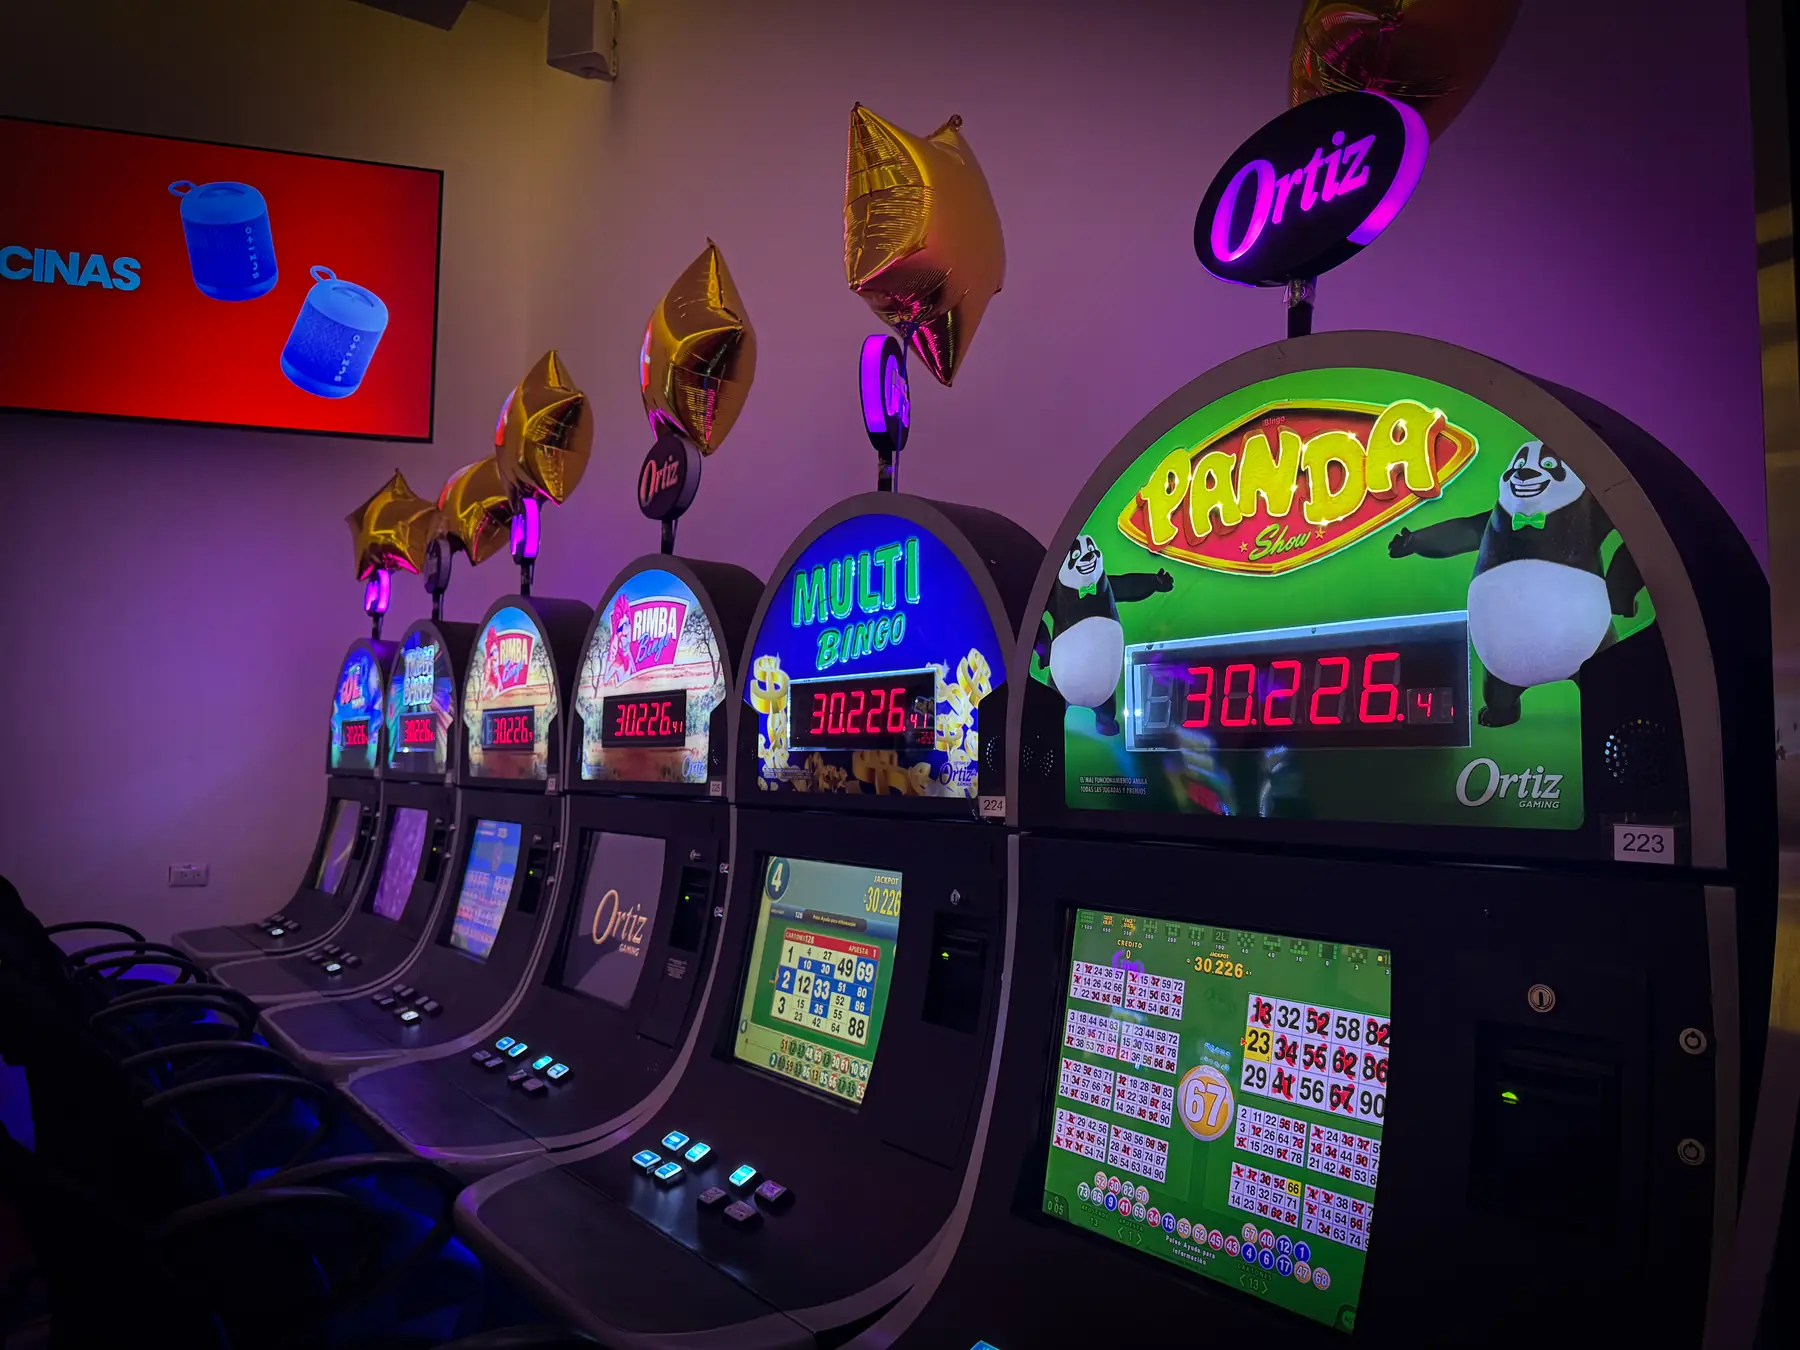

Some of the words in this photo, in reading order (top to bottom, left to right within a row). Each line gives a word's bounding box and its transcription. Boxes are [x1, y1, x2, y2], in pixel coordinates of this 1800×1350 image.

[1211, 130, 1376, 262] Ortiz
[0, 245, 141, 291] CINAS
[640, 453, 680, 505] Ortiz
[1139, 400, 1443, 548] PANDA
[1249, 523, 1312, 561] Show
[791, 536, 922, 627] MULTI
[632, 605, 677, 641] RIMBA
[815, 613, 907, 670] BINGO
[940, 760, 972, 786] Ortiz
[1455, 757, 1564, 807] Ortiz
[983, 799, 1003, 811] 224
[1519, 800, 1560, 809] GAMING
[1622, 832, 1665, 854] 223
[771, 862, 783, 892] 4
[873, 875, 899, 885] JACKPOT
[592, 889, 648, 946] Ortiz
[1117, 939, 1143, 949] CREDITO
[1209, 951, 1229, 959] JACKPOT
[788, 946, 793, 963] 1
[823, 951, 832, 961] 27
[838, 958, 853, 977] 49
[856, 961, 874, 983] 69
[803, 960, 812, 969] 10
[821, 964, 830, 975] 30
[1115, 970, 1124, 980] 57
[781, 971, 791, 989] 2
[798, 975, 811, 994] 12
[814, 979, 830, 1000] 33
[837, 982, 846, 993] 51
[857, 987, 867, 998] 80
[1081, 989, 1090, 998] 22
[1162, 979, 1171, 989] 59
[1174, 981, 1183, 992] 72
[835, 996, 845, 1006] 52
[855, 1001, 865, 1012] 86
[778, 997, 786, 1014] 3
[797, 999, 805, 1009] 15
[814, 1004, 824, 1014] 35
[833, 1010, 843, 1020] 55
[848, 1017, 865, 1039] 88
[1171, 1007, 1180, 1018] 74
[794, 1012, 802, 1022] 23
[812, 1017, 821, 1028] 42
[831, 1023, 840, 1034] 64
[1253, 1001, 1273, 1024] 13
[1277, 1006, 1300, 1030] 32
[1306, 1011, 1330, 1036] 52
[1335, 1016, 1360, 1041] 58
[1366, 1021, 1390, 1047] 82
[1098, 1031, 1105, 1041] 71
[1168, 1034, 1178, 1045] 72
[1247, 1030, 1270, 1054] 23
[1274, 1038, 1297, 1063] 34
[1302, 1044, 1327, 1070] 55
[1333, 1050, 1358, 1077] 62
[1363, 1056, 1388, 1083] 86
[1162, 1087, 1172, 1098] 83
[1244, 1065, 1266, 1089] 29
[1272, 1072, 1292, 1096] 41
[1299, 1077, 1324, 1103] 56
[1330, 1084, 1355, 1110] 67
[1360, 1091, 1386, 1118] 90
[1101, 1097, 1110, 1107] 87
[1161, 1101, 1171, 1112] 84
[1185, 1078, 1227, 1128] 67
[1253, 1112, 1262, 1123] 11
[1278, 1133, 1289, 1145] 64
[1326, 1131, 1338, 1143] 24
[1096, 1149, 1104, 1160] 74
[1144, 1151, 1153, 1162] 74
[1291, 1151, 1302, 1164] 78
[1340, 1150, 1352, 1163] 44
[1109, 1154, 1118, 1165] 36
[1154, 1169, 1164, 1180] 90
[1095, 1175, 1106, 1186] 52
[1109, 1180, 1119, 1191] 30
[1354, 1169, 1367, 1182] 53
[1246, 1184, 1256, 1196] 18
[1258, 1188, 1270, 1201] 32
[1288, 1182, 1299, 1194] 66
[1321, 1208, 1331, 1220] 14
[1078, 1186, 1089, 1198] 73
[1120, 1201, 1129, 1213] 41
[1134, 1206, 1144, 1218] 69
[1148, 1211, 1159, 1223] 34
[1164, 1216, 1174, 1229] 13
[1179, 1223, 1190, 1235] 55
[1194, 1228, 1205, 1241] 62
[1210, 1234, 1221, 1247] 45
[1226, 1240, 1238, 1253] 43
[1280, 1259, 1290, 1272] 17
[1297, 1266, 1308, 1279] 47
[1315, 1273, 1328, 1286] 68
[1244, 1227, 1256, 1240] 67
[1333, 1228, 1346, 1241] 63
[1349, 1233, 1361, 1246] 74
